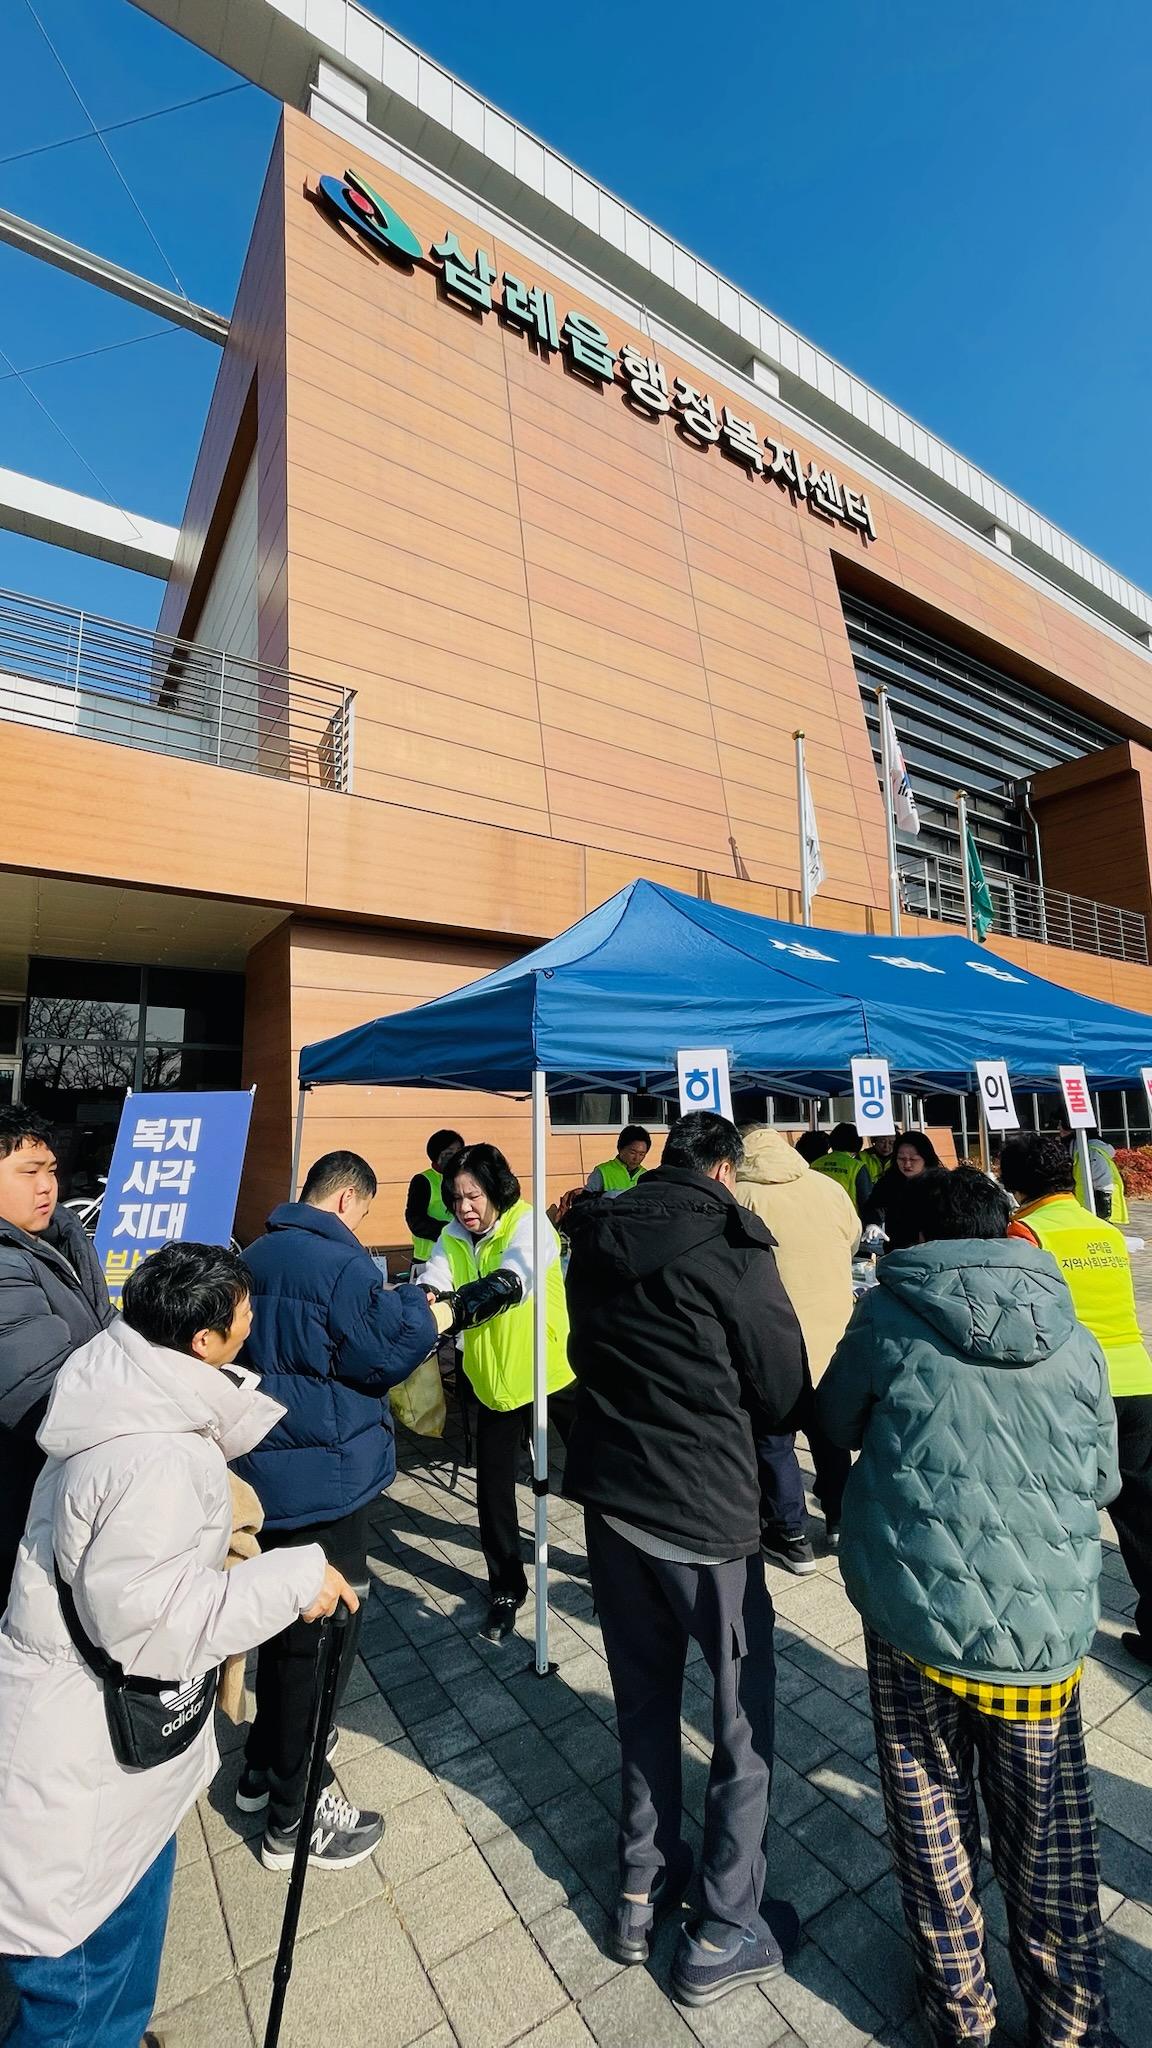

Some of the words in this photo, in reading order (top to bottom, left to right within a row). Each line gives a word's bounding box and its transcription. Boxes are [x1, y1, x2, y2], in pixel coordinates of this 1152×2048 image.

[431, 231, 615, 383] 삼례읍
[618, 343, 878, 540] 행정복지센터
[685, 1067, 722, 1114] 희
[858, 1075, 885, 1119] 망
[984, 1074, 1009, 1113] 의
[132, 1118, 202, 1152] 복지
[121, 1160, 196, 1195] 사각
[111, 1203, 189, 1239] 지대
[104, 1249, 160, 1286] 발
